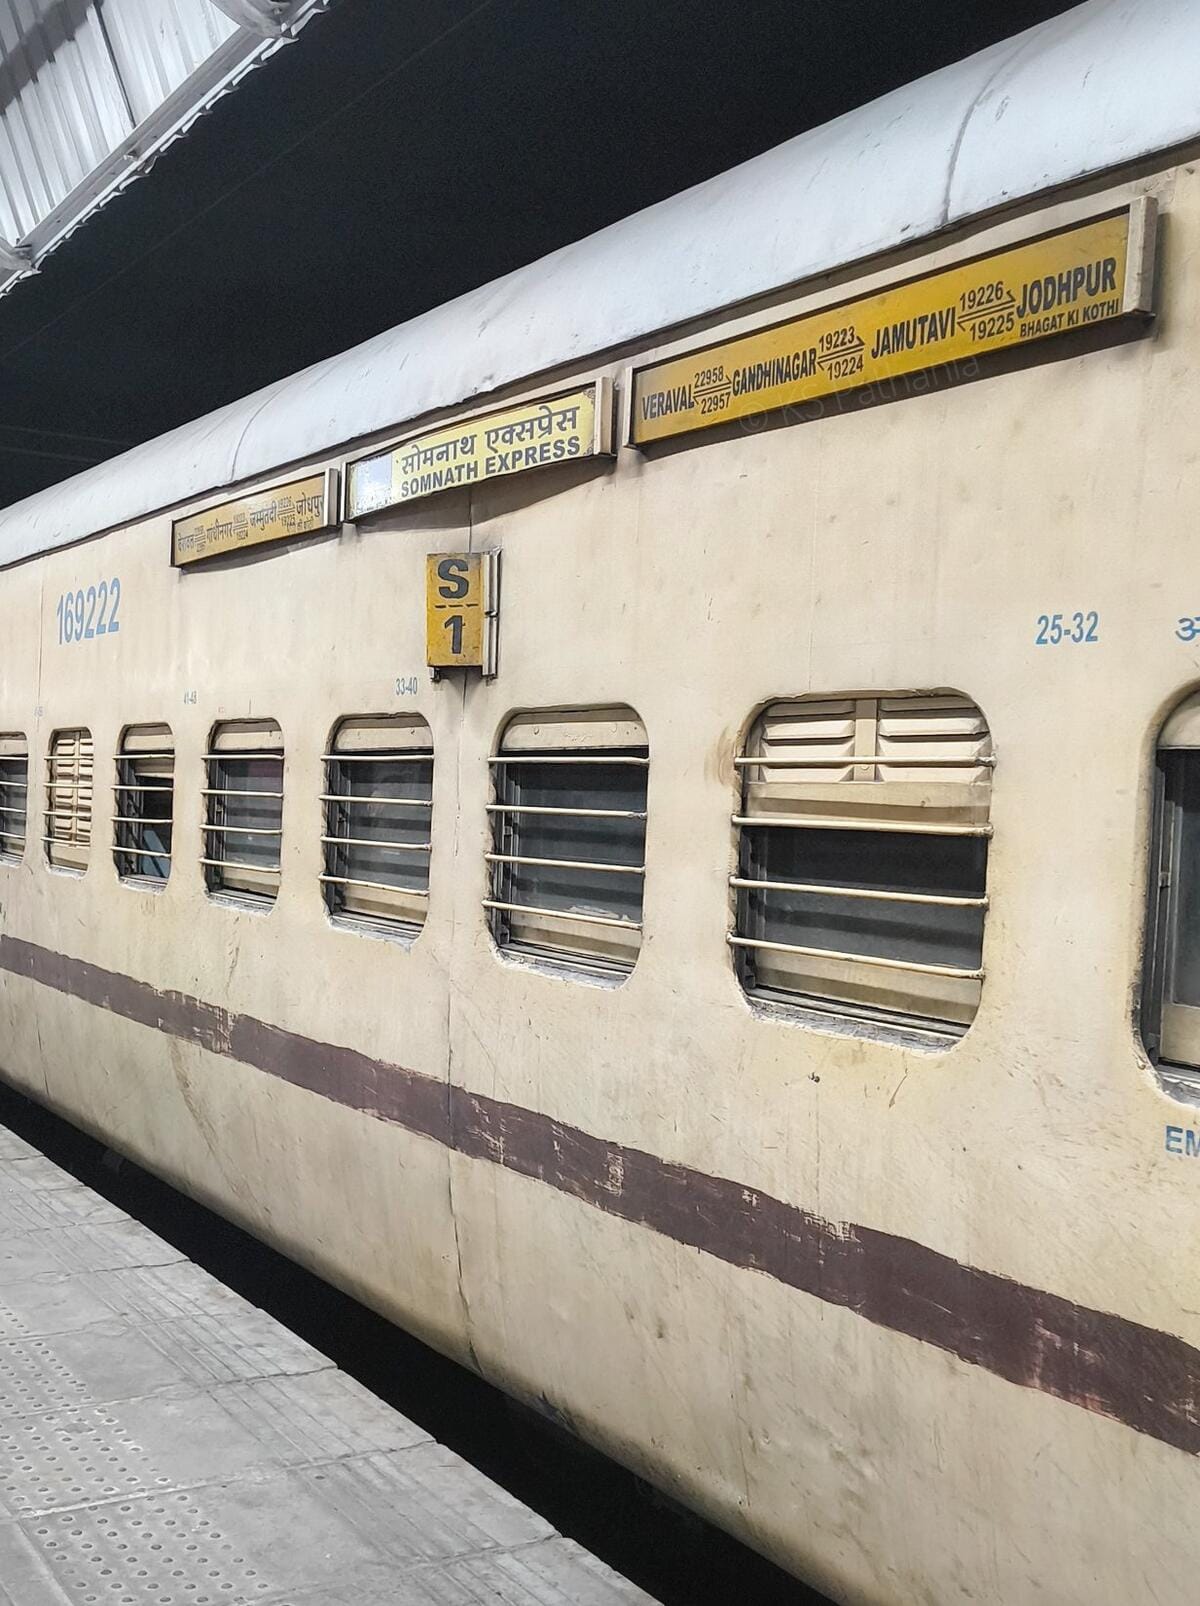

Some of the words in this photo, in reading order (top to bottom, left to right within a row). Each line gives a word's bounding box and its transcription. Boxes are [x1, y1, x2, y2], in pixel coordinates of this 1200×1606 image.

[959, 280, 1004, 311] 19226
[969, 311, 1015, 342] 19225
[1019, 316, 1063, 338] BHAGAT
[1067, 308, 1079, 325] KI
[1082, 298, 1119, 323] KOTHI
[642, 383, 695, 420] VERAVAL
[732, 347, 817, 396] GANDHINAGAR
[871, 307, 957, 359] JAMUTAVI
[1016, 257, 1117, 318] JODHPUR
[819, 326, 856, 352] 19223
[694, 365, 724, 389] 22958
[827, 354, 864, 381] 19224
[701, 391, 731, 415] 22957
[401, 434, 477, 475] सोमनाथ
[485, 405, 581, 453] एक्सप्रेस
[401, 460, 478, 497] SOMNATH
[485, 435, 581, 474] EXPRESS
[437, 558, 469, 599] S
[56, 577, 121, 645] 169222
[1035, 610, 1099, 645] 25-32
[444, 615, 465, 655] 1
[395, 677, 418, 696] 33-40
